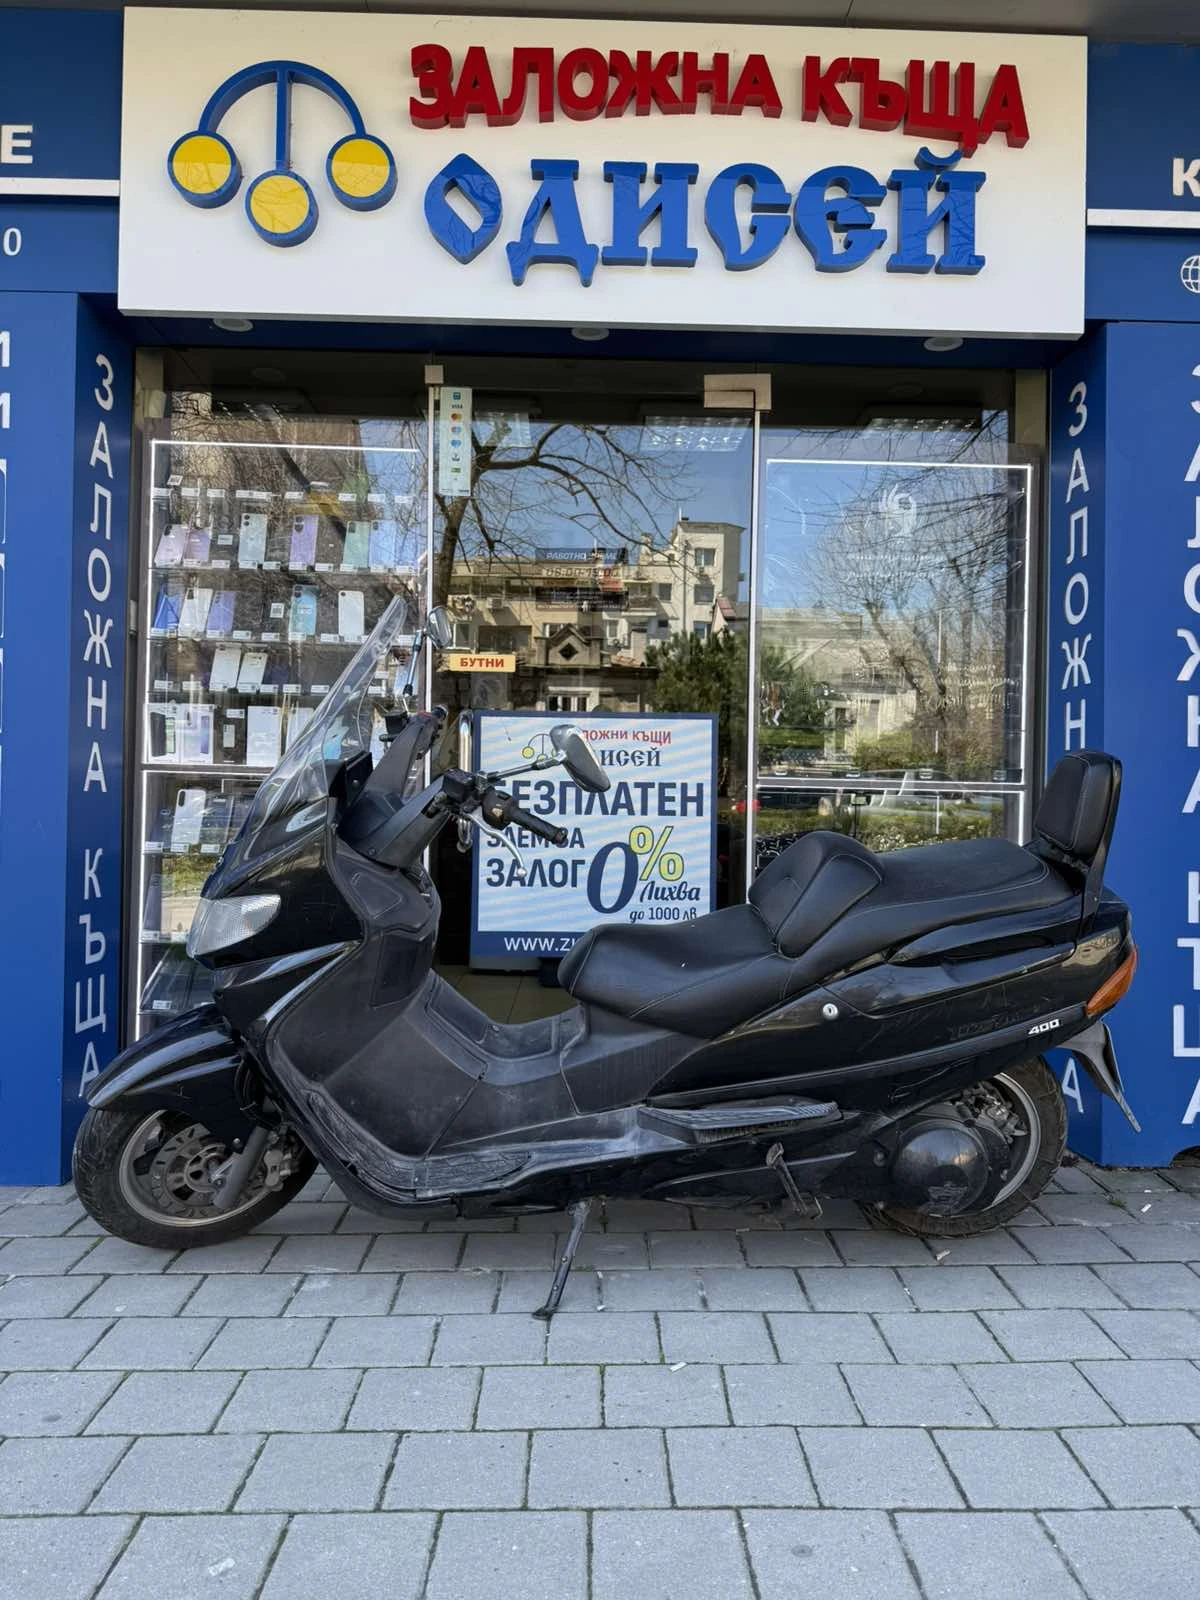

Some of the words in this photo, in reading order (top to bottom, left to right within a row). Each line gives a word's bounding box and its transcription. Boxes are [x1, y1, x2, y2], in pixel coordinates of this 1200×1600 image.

[409, 43, 780, 129] ЗАЛОЖНА
[801, 55, 1030, 158] КЪЩА
[424, 146, 987, 287] ОДИСЕЙ
[83, 353, 115, 793] ЗАЛОЖНА
[1061, 381, 1092, 752] ЗАЛОЖН
[460, 657, 504, 668] БУТНИ
[582, 729, 628, 741] ЛОЖНИ
[632, 729, 672, 745] КЪЩИ
[600, 746, 662, 767] ИСЕЙ
[486, 859, 586, 888] ЗАЛОГ
[640, 881, 701, 903] Лихва
[648, 907, 680, 920] 1000
[75, 847, 107, 1097] КЪЩА
[1027, 1018, 1060, 1036] 400
